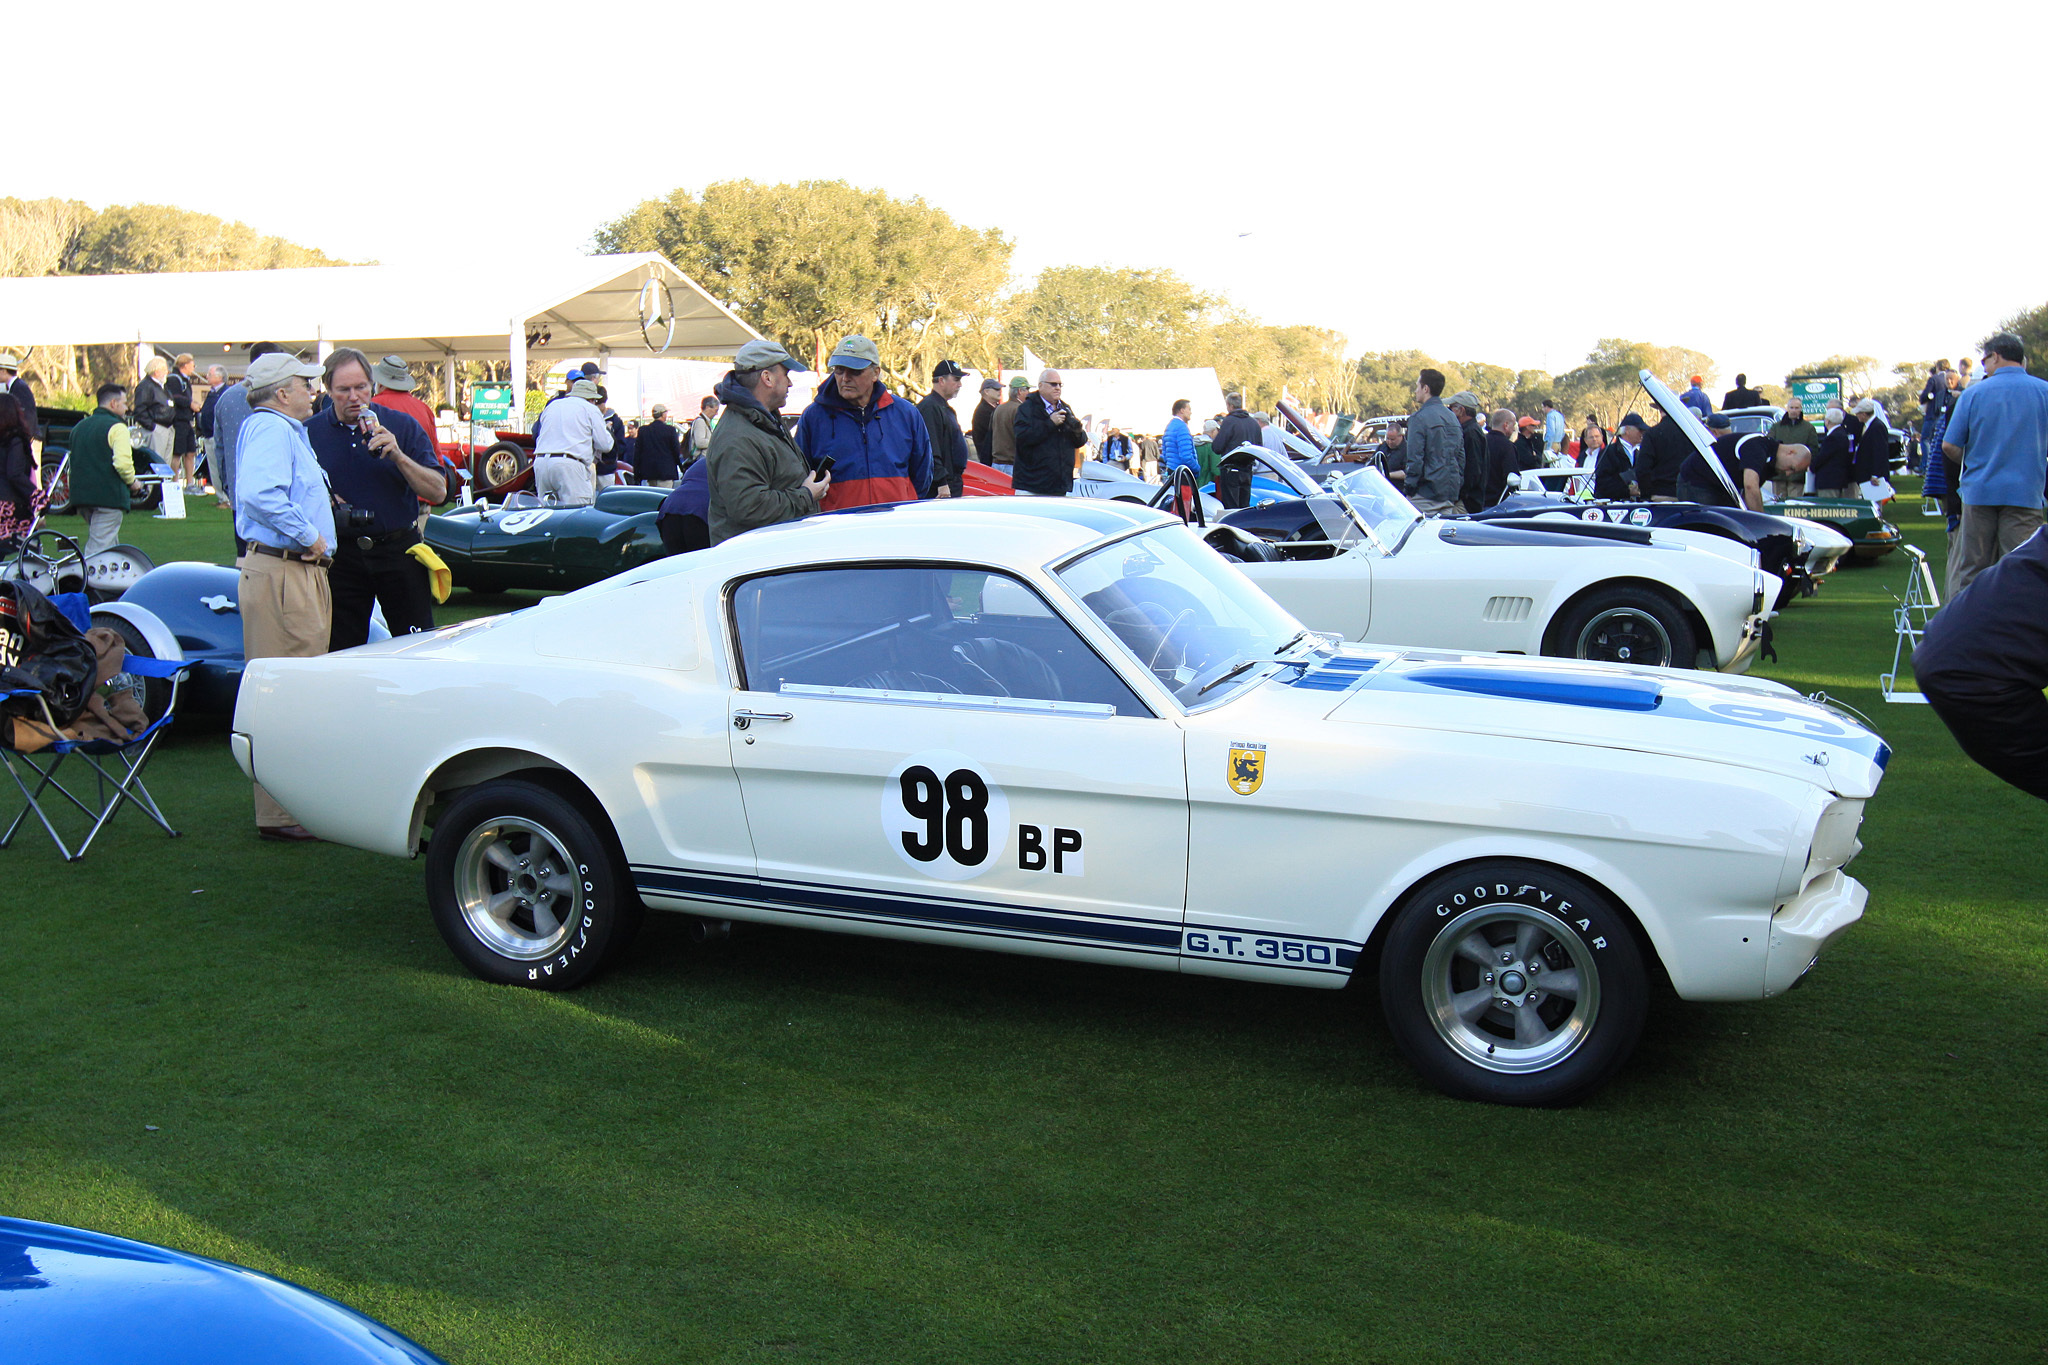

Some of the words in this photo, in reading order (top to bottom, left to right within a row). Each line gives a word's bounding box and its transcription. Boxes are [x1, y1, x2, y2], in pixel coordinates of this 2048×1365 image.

[1804, 392, 1836, 400] ANNIVERSARY
[505, 511, 547, 526] 31
[900, 765, 989, 866] 98
[1018, 824, 1082, 874] BP
[528, 864, 595, 980] GOODYEAR
[1436, 884, 1607, 950] GOODYEAR
[1186, 933, 1245, 957] G.T.
[1255, 939, 1332, 965] 350
